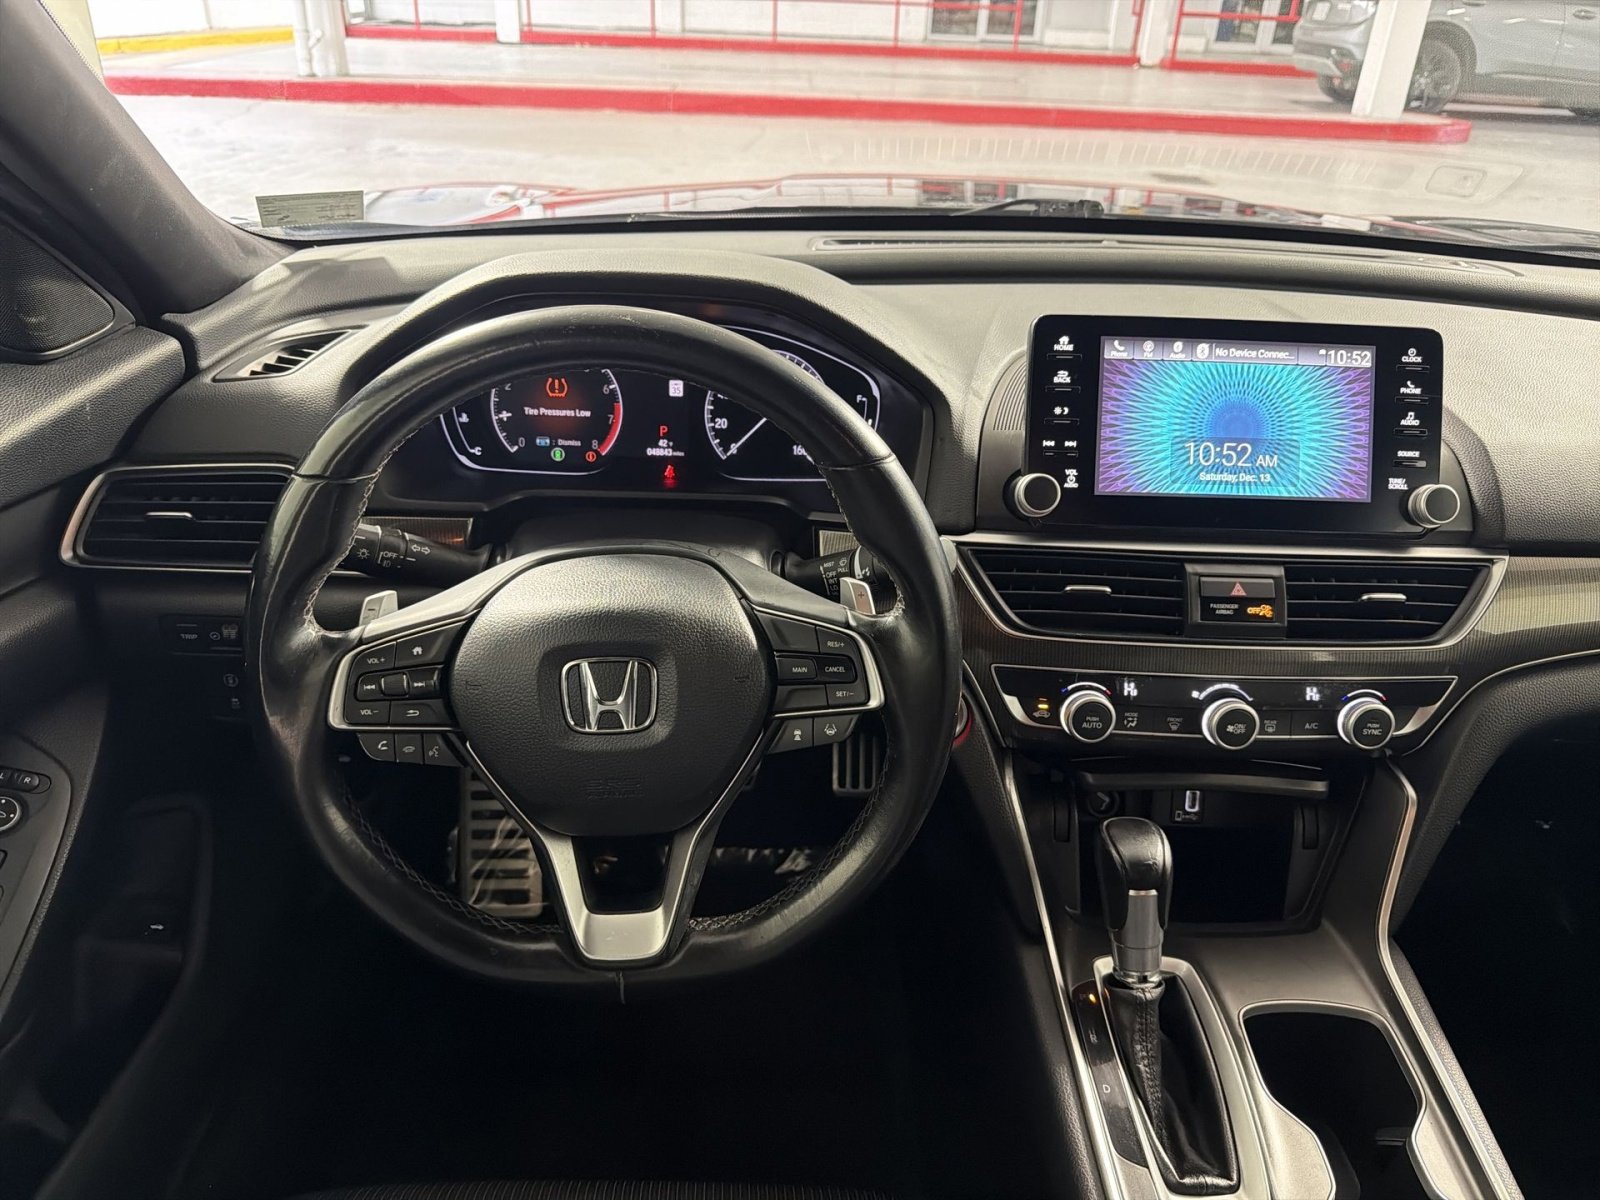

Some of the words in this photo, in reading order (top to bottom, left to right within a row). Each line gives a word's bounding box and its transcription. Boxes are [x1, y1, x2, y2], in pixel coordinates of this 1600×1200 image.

[1215, 347, 1228, 357] No
[1230, 348, 1256, 358] Device
[1328, 350, 1372, 366] 10:52
[603, 384, 609, 394] 6
[523, 406, 539, 416] Tire
[539, 407, 575, 417] Pressures
[575, 409, 591, 417] Low
[607, 414, 613, 424] 7
[714, 418, 728, 429] 20
[660, 425, 668, 436] P
[591, 440, 598, 450] 8
[658, 439, 668, 447] 42
[1184, 441, 1252, 467] 10:52
[1256, 455, 1278, 467] AM
[1199, 472, 1238, 483] Saturday,
[1239, 473, 1256, 481] Dec.
[1260, 474, 1271, 482] 13
[383, 551, 398, 559] OFF
[1247, 606, 1261, 614] OFF
[1081, 721, 1103, 729] AUTO
[23, 776, 32, 784] R
[1102, 1084, 1111, 1094] D
